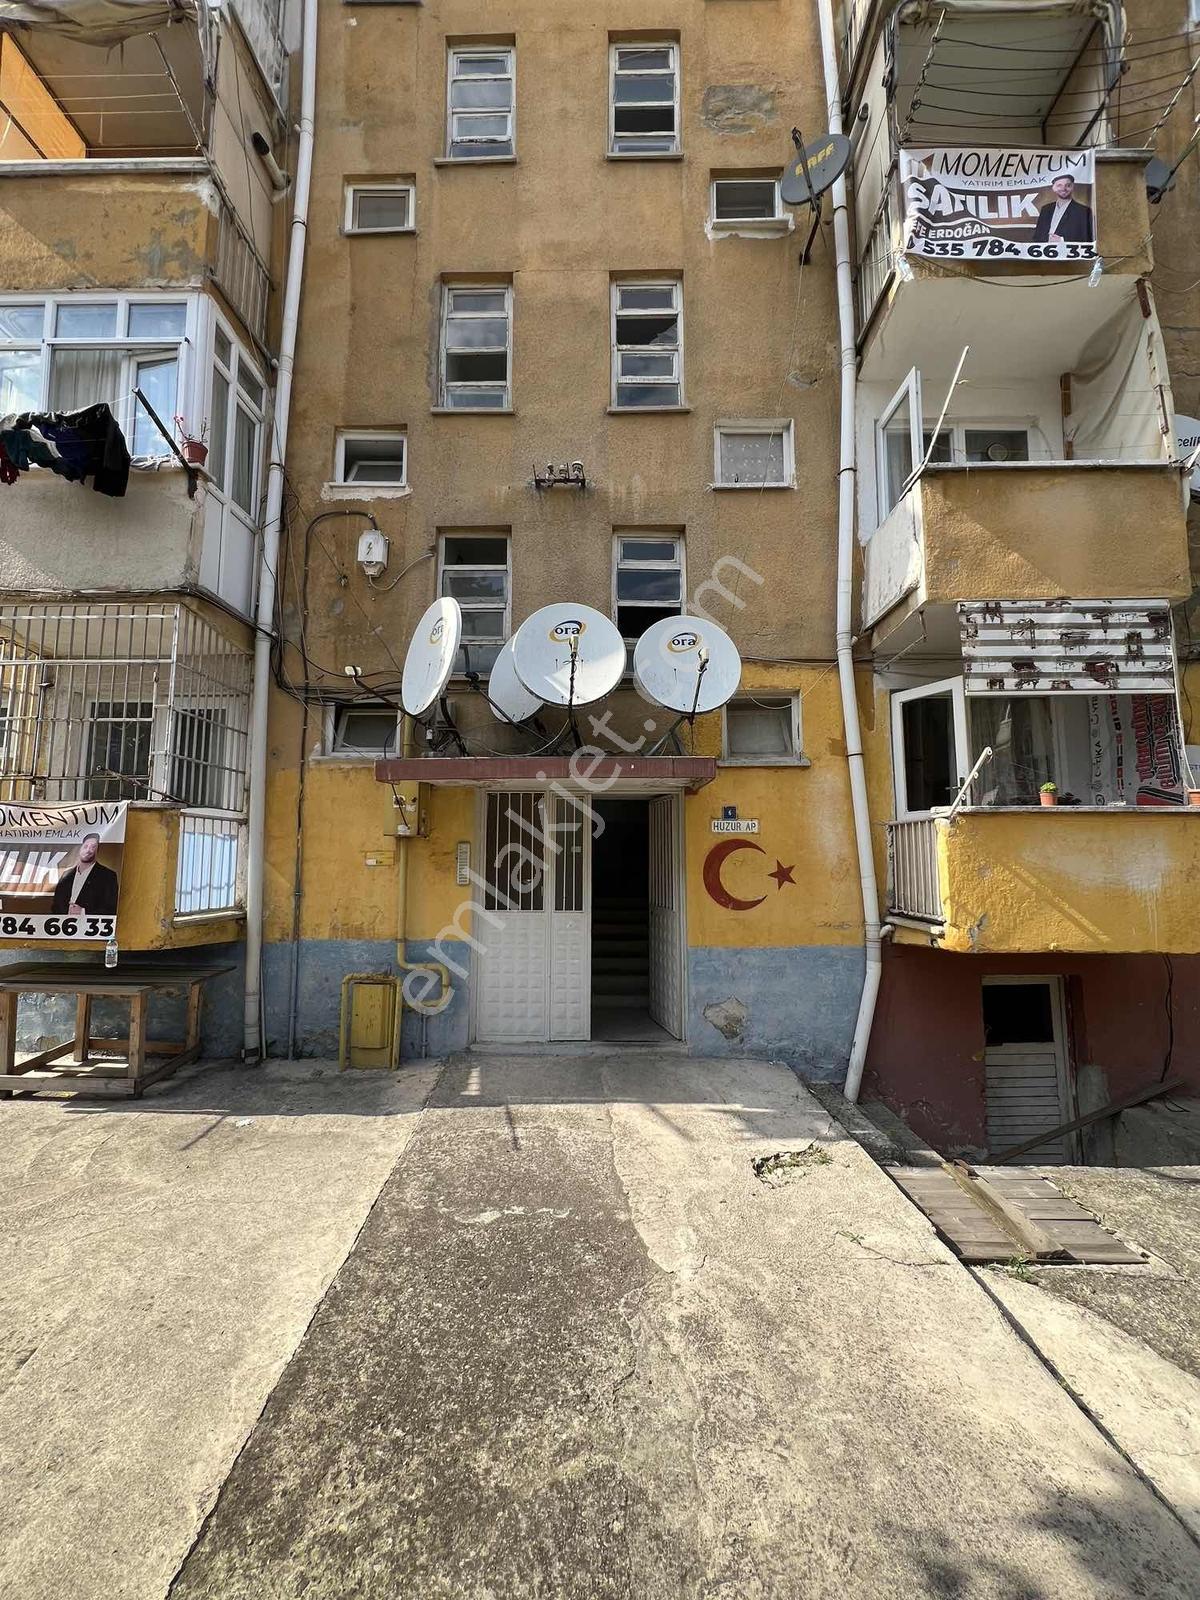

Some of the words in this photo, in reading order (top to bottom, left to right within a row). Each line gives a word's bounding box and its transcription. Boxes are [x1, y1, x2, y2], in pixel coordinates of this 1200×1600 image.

[939, 151, 1087, 178] MOMENTUM
[961, 178, 1004, 188] YATIRIM
[1006, 177, 1047, 187] EMLAK
[907, 181, 1040, 219] SATILIK
[922, 239, 964, 257] 535
[972, 239, 1021, 257] 784
[1027, 244, 1059, 259] 66
[1066, 244, 1096, 259] 33
[554, 627, 580, 635] ora
[672, 638, 696, 646] ora
[0, 805, 119, 828] MENTUM
[713, 821, 741, 831] HUZUR
[745, 821, 757, 831] AP
[45, 829, 81, 839] EMLAK
[0, 850, 69, 885] LIK
[0, 917, 36, 935] 84
[43, 917, 78, 936] 66
[84, 918, 114, 937] 33
